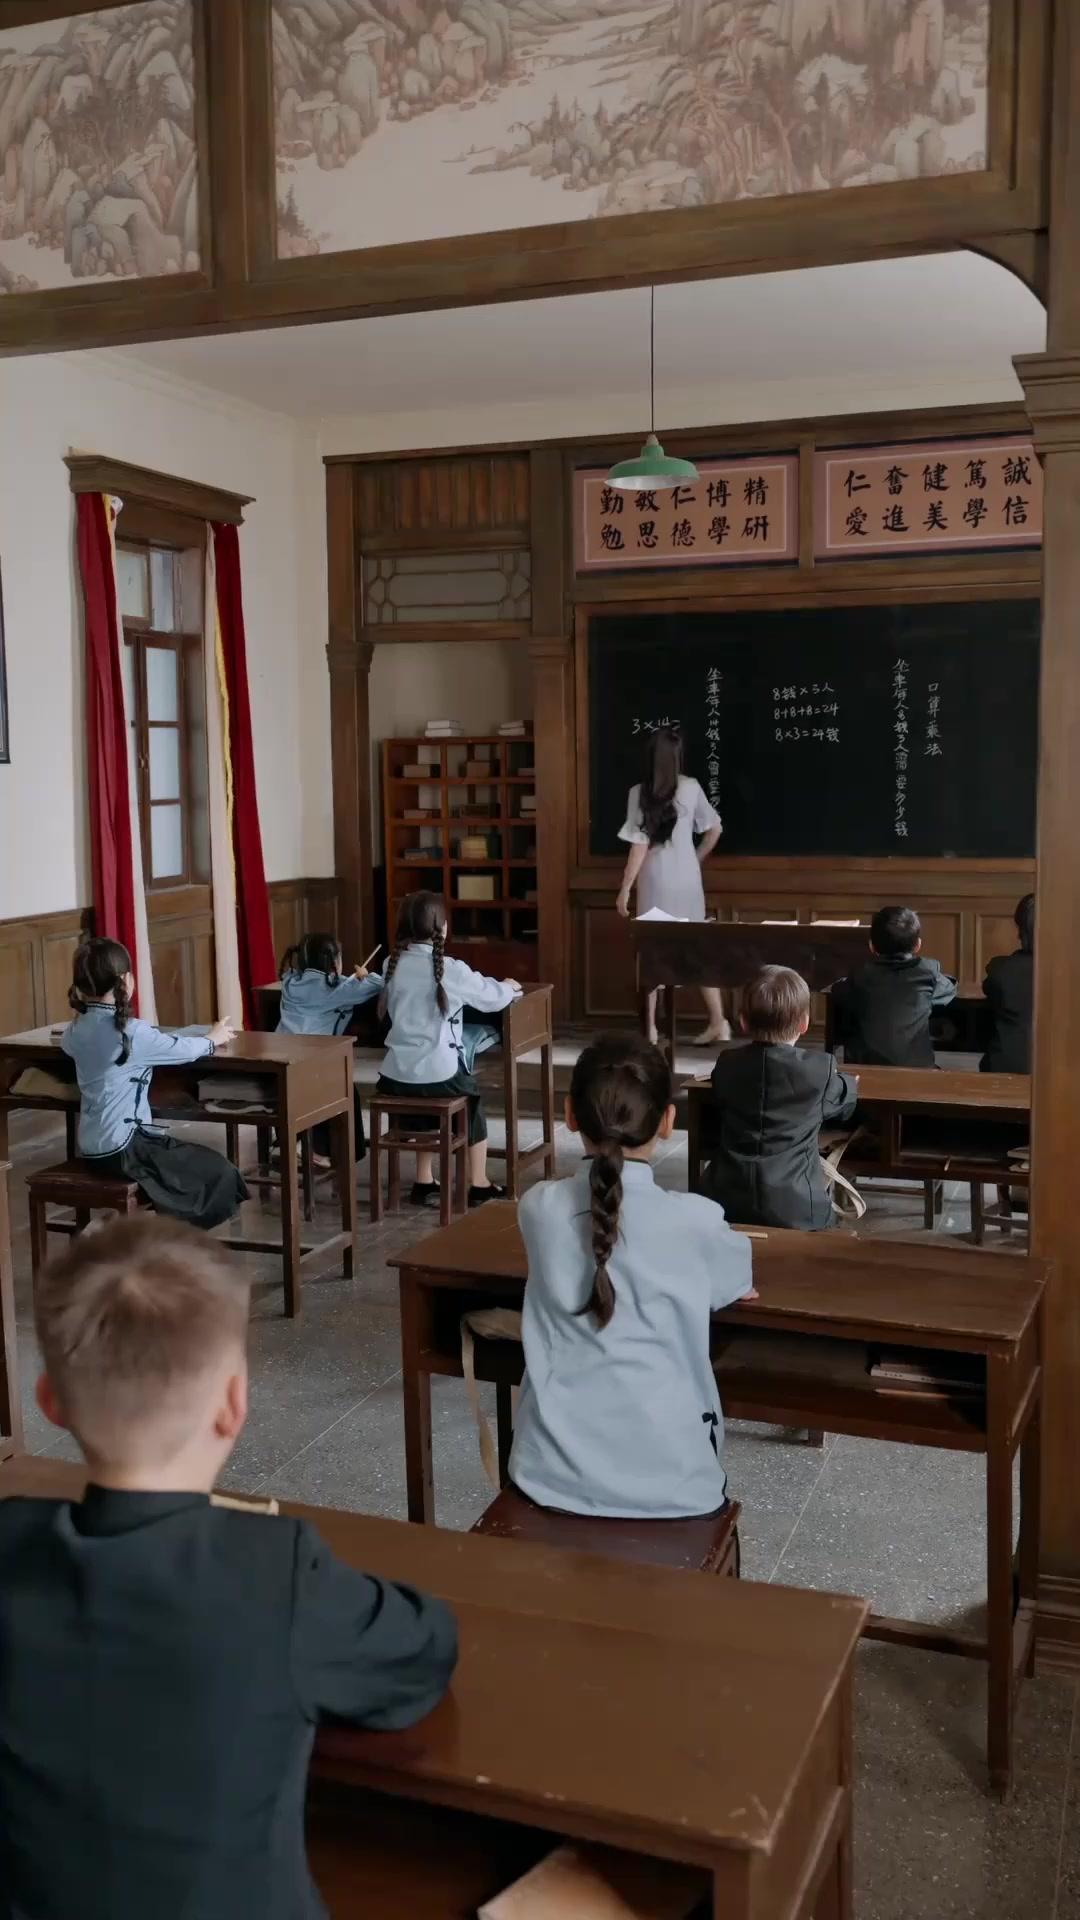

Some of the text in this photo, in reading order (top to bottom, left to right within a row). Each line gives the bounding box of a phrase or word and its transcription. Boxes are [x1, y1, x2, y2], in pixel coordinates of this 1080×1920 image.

[600, 488, 625, 550] 勤勉
[670, 486, 697, 548] 仁德
[706, 479, 732, 545] 博學
[843, 469, 871, 536] 仁愛
[882, 465, 909, 533] 奮進
[922, 462, 949, 531] 健美
[962, 458, 988, 529] 篤學
[1001, 456, 1032, 526] 誠信
[924, 682, 943, 756] 口算乘法
